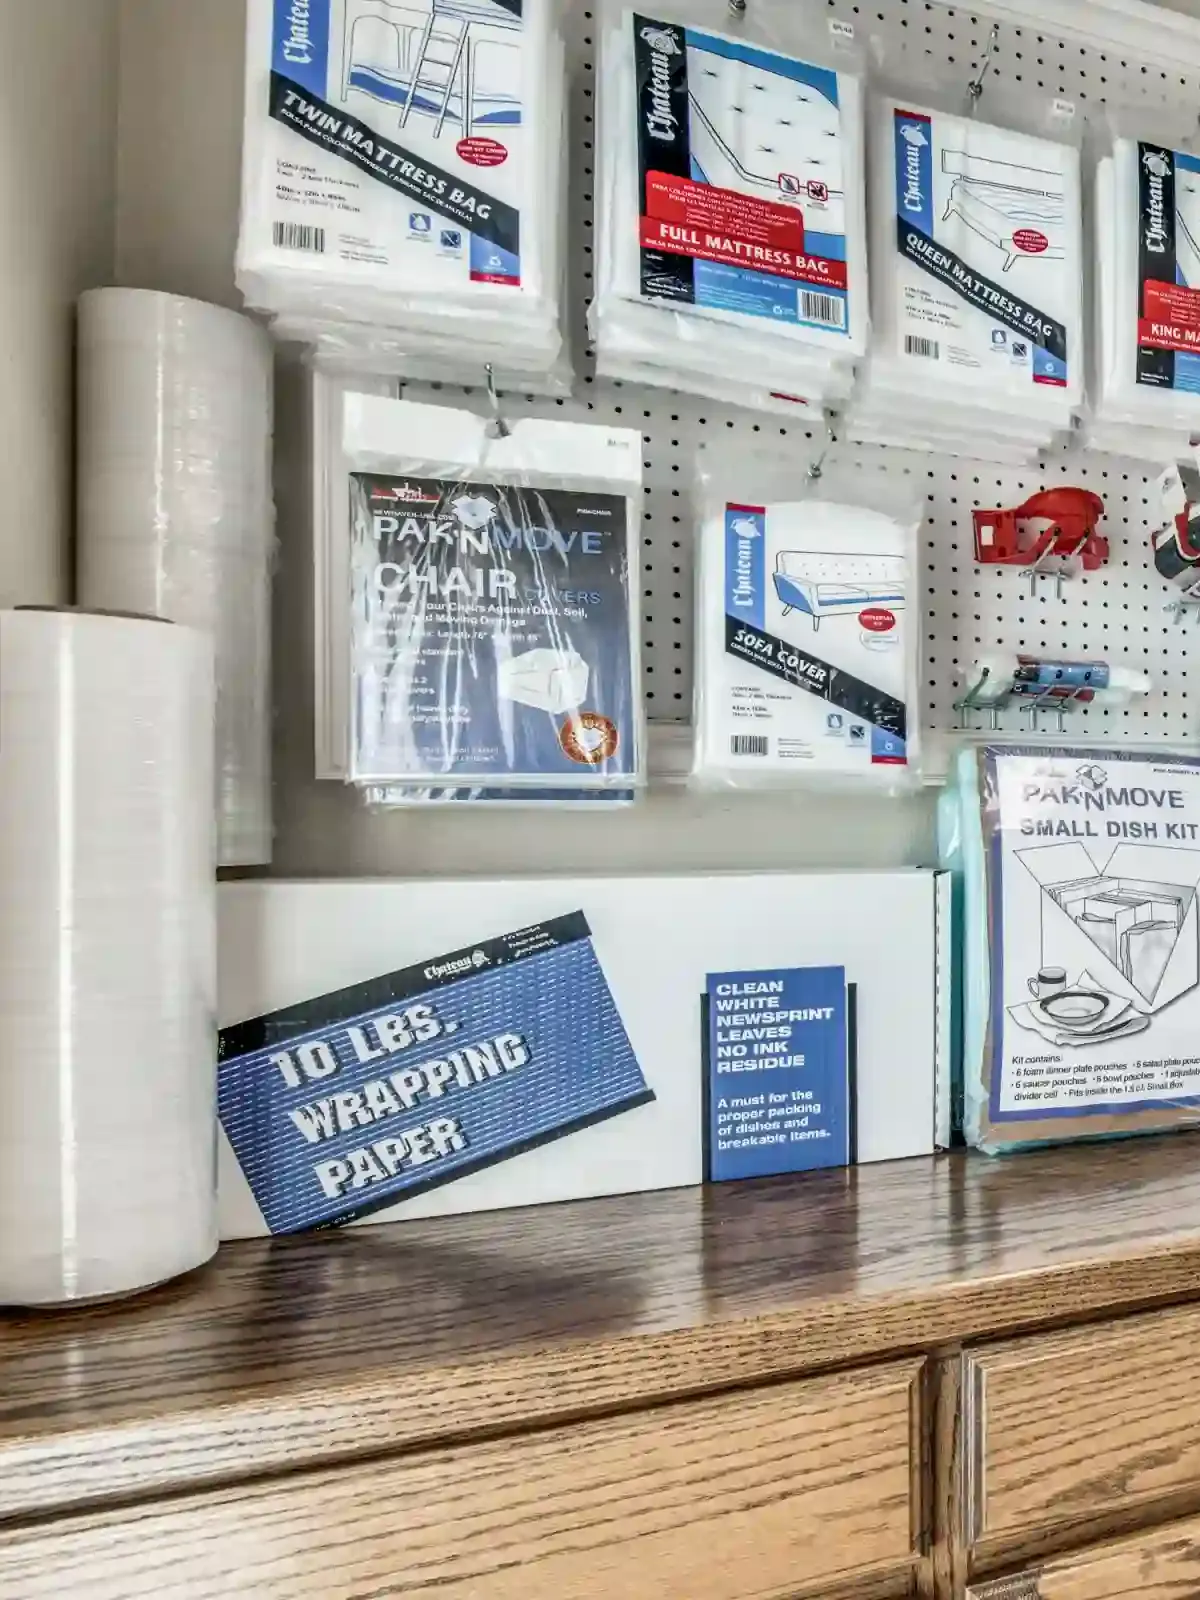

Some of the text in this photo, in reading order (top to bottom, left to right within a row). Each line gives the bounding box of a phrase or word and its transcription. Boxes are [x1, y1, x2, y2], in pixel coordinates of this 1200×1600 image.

[283, 89, 343, 135] TWIN
[340, 121, 448, 195] MATTRESS
[449, 187, 492, 220] BAG
[660, 223, 701, 244] FULL
[705, 234, 792, 265] MATTRESS
[796, 255, 829, 274] BAG
[905, 232, 952, 270] QUEEN
[952, 263, 1023, 317] MATTRESS
[1023, 312, 1053, 337] BAG
[1151, 323, 1181, 340] KING
[372, 561, 517, 600] CHAIR
[563, 607, 588, 619] Soil,
[733, 629, 827, 682] SOFA COVER
[1020, 818, 1199, 840] SMALL DISH KIT
[423, 956, 472, 981] Chateau
[716, 980, 784, 996] CLEAN
[716, 996, 780, 1012] WHITE
[716, 1007, 835, 1027] NEWSPRINT
[716, 1025, 793, 1042] LEAVES
[269, 1003, 463, 1090] 10 LBS.
[717, 1041, 789, 1058] NO INK
[717, 1055, 805, 1074] RESIDUE
[1011, 1056, 1024, 1065] Kit
[1023, 1067, 1045, 1076] foam
[1073, 1064, 1093, 1075] plate
[1093, 1062, 1128, 1074] pouches
[288, 1032, 532, 1144] WRAPPING
[1015, 1081, 1022, 1089] 6
[1052, 1077, 1087, 1089] pouches
[1103, 1073, 1123, 1083] bowl
[1123, 1071, 1155, 1083] pouches
[717, 1089, 813, 1109] A must for the
[1014, 1092, 1042, 1101] divider
[1068, 1088, 1084, 1098] Fits
[1109, 1085, 1124, 1095] the
[1169, 1080, 1184, 1090] Box
[718, 1102, 821, 1124] proper packing
[718, 1116, 809, 1137] of dishes and
[718, 1132, 787, 1150] breakable
[313, 1116, 470, 1200] PAPER
